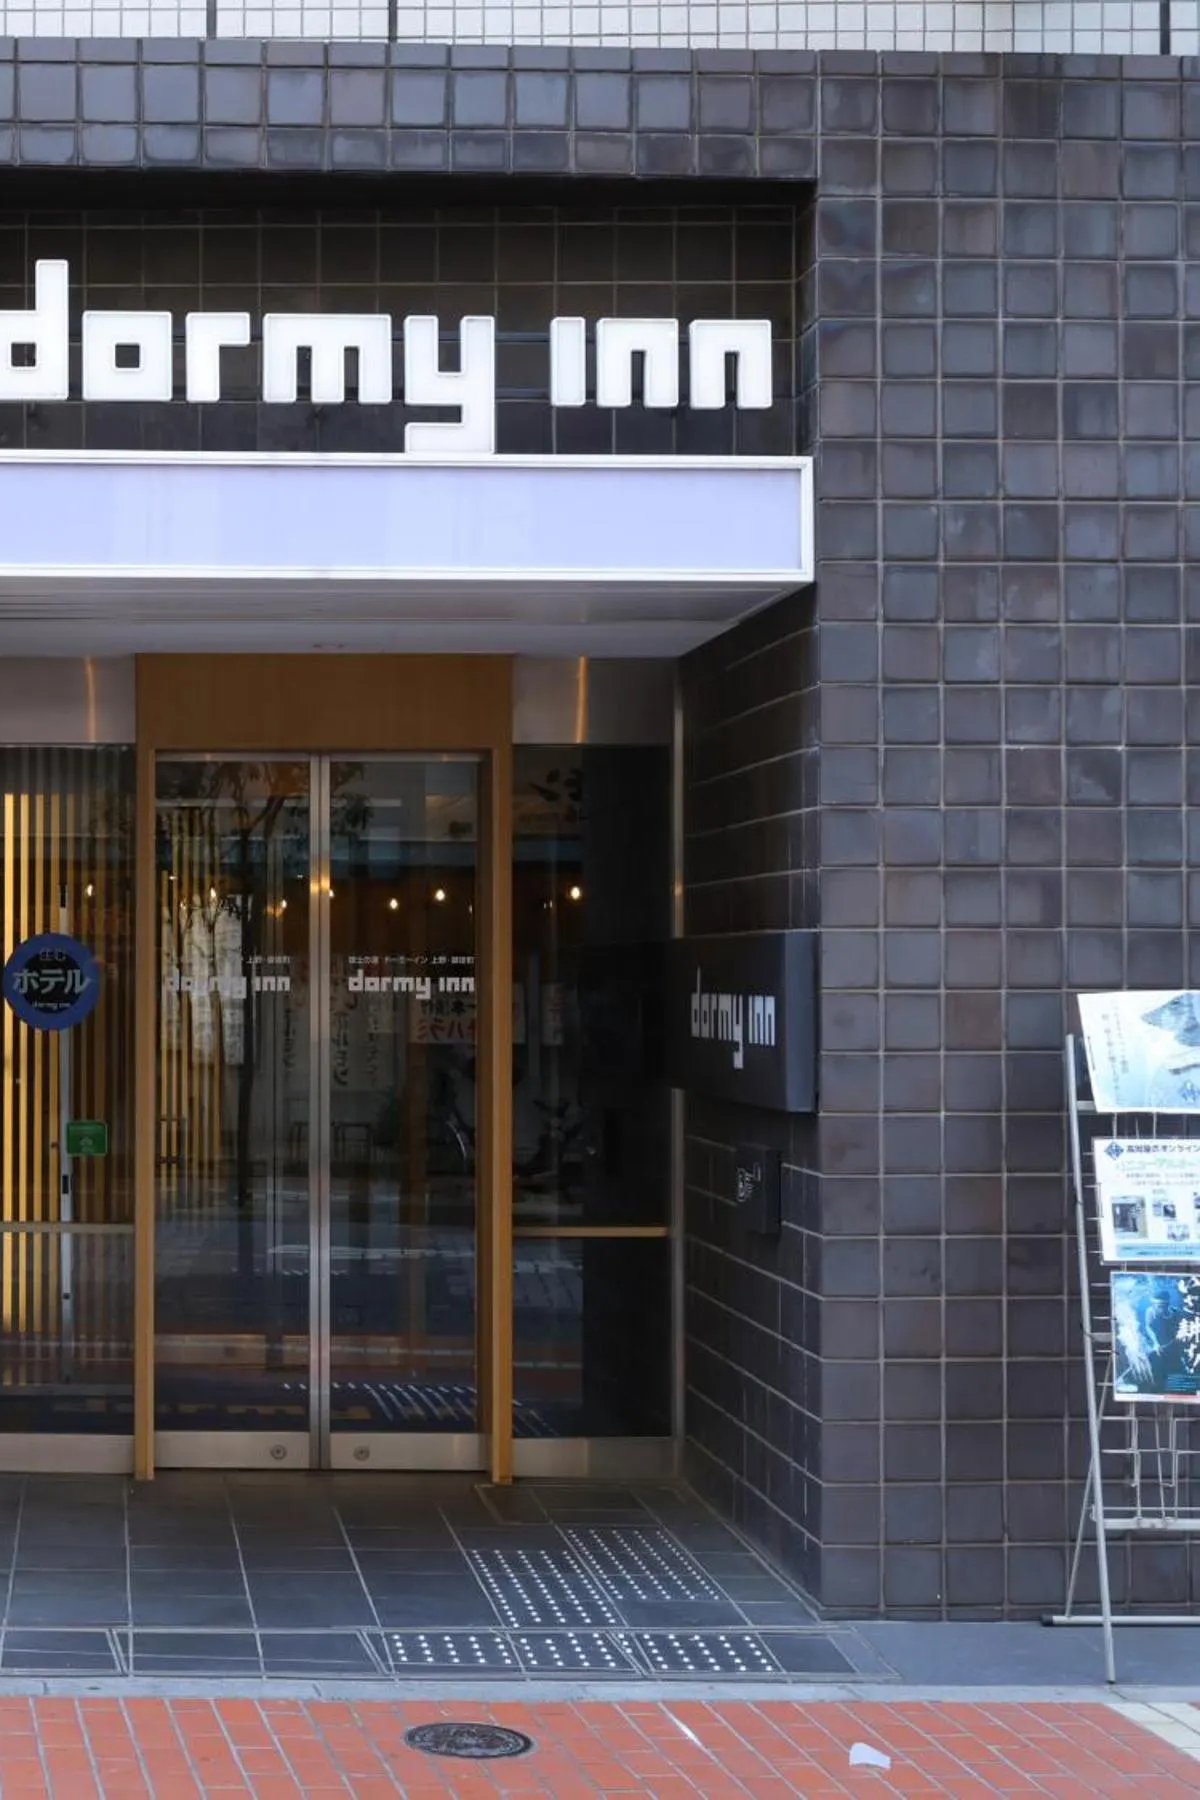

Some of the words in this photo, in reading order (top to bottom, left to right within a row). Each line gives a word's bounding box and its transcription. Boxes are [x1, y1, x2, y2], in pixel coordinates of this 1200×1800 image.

[549, 316, 773, 409] inn
[12, 968, 93, 995] ホテル
[254, 976, 291, 992] inn
[348, 968, 432, 1000] dormy
[439, 976, 475, 992] inn
[691, 965, 744, 1069] dormy
[748, 995, 776, 1046] inn
